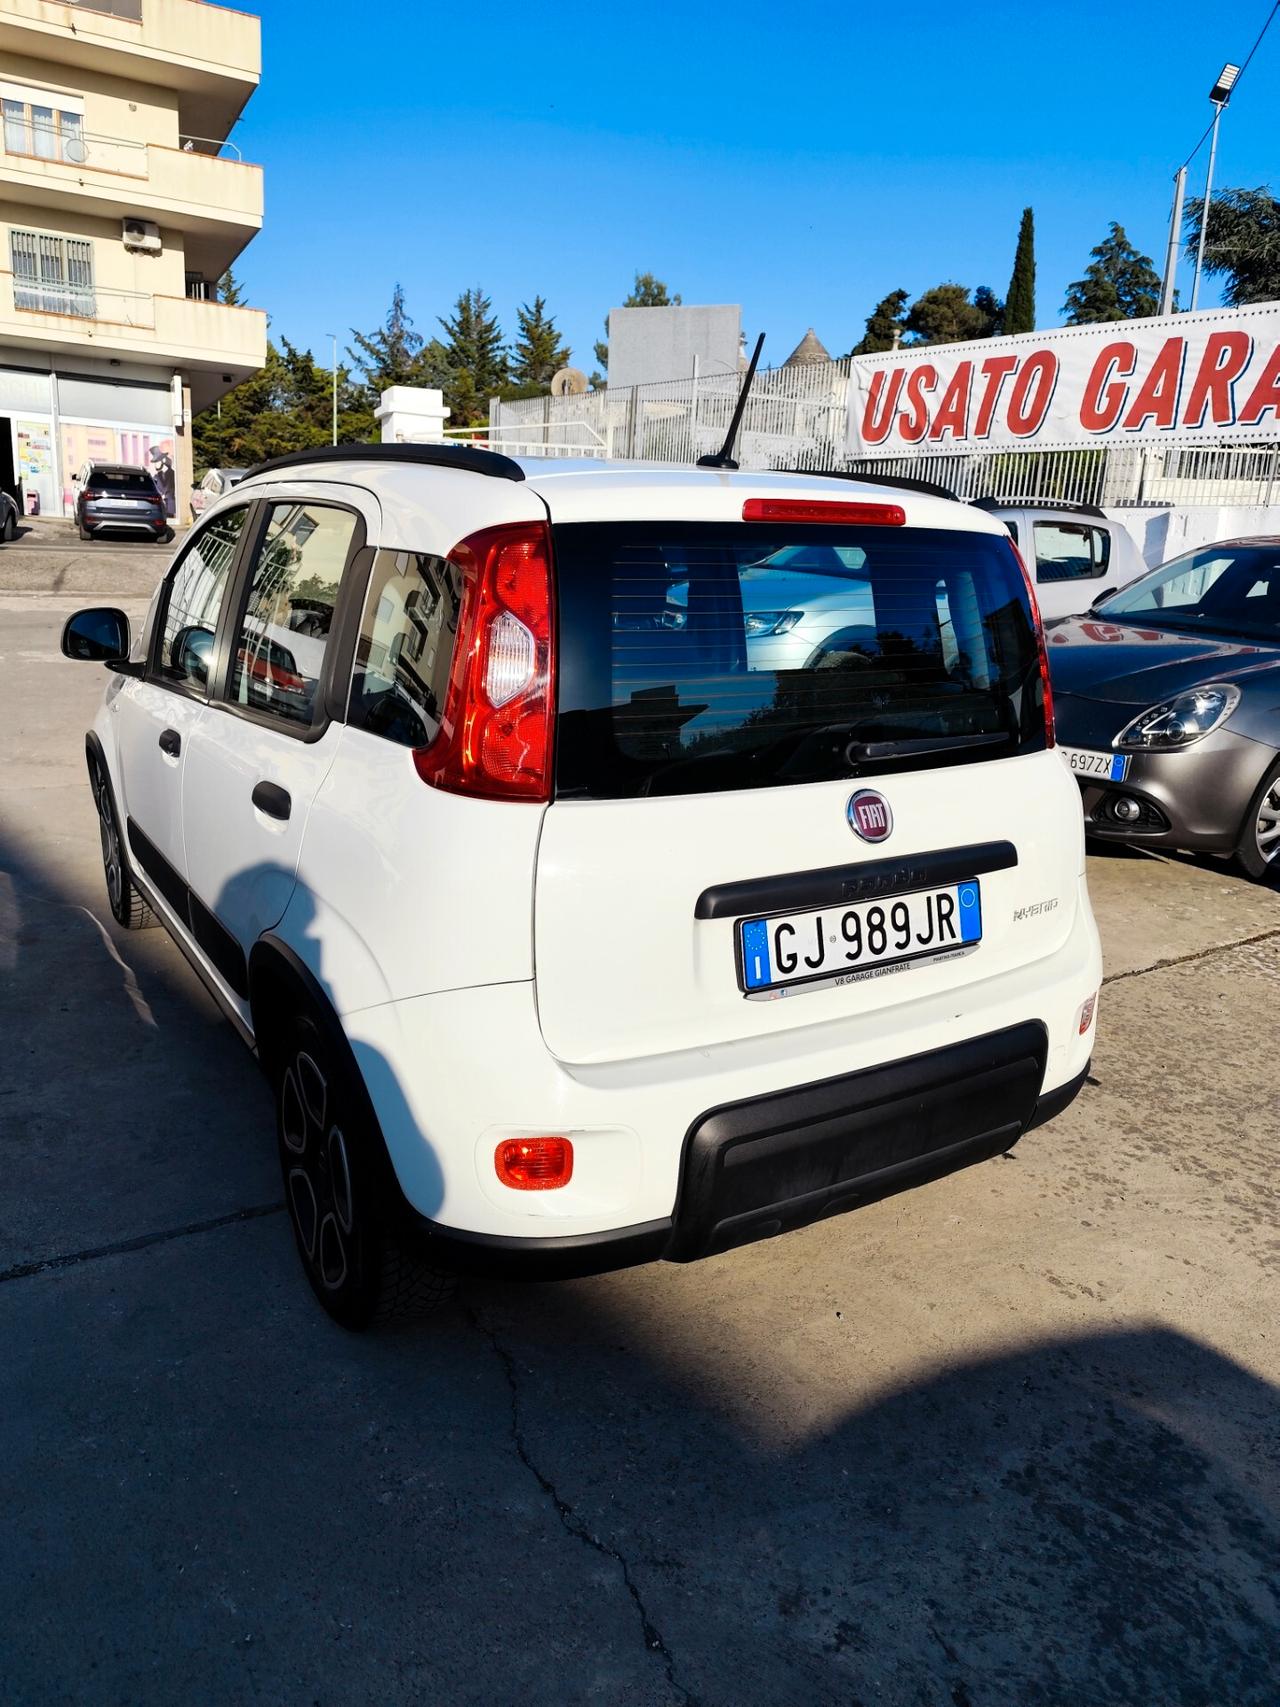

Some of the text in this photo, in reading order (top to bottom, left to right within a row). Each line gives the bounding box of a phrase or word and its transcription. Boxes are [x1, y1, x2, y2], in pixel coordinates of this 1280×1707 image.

[861, 349, 1059, 445] USATO
[857, 803, 886, 830] FIAT
[834, 962, 911, 986] V8 GARAGE GIANFRATE
